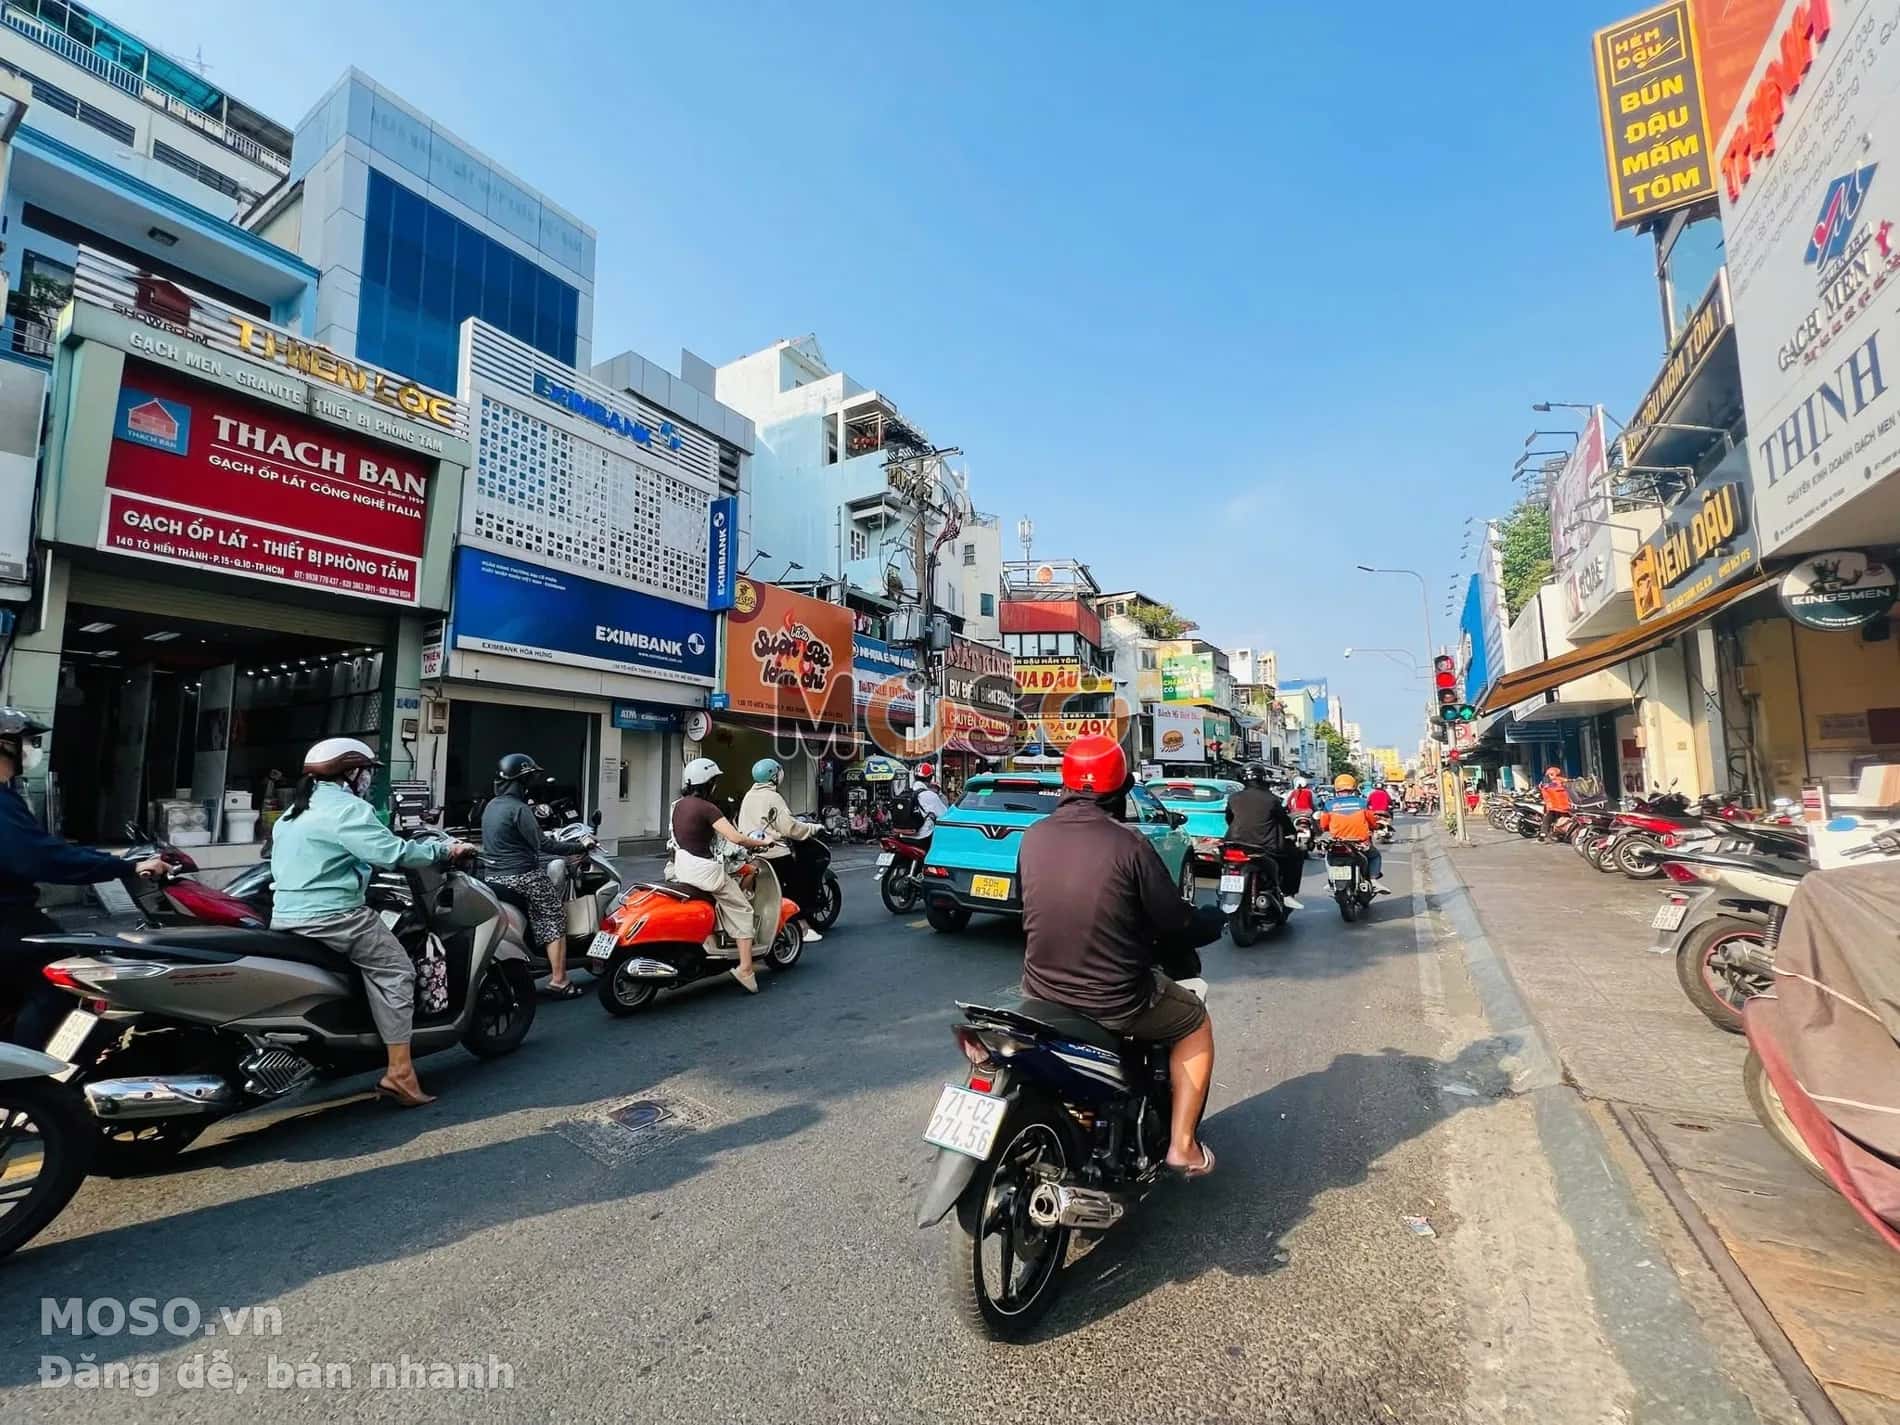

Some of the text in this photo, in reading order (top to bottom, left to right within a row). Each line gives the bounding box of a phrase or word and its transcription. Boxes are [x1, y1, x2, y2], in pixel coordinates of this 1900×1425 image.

[1620, 75, 1685, 114] BÚN
[1624, 106, 1690, 144] ĐẬU
[1622, 134, 1699, 177] MẮM
[1629, 167, 1701, 205] TÔM
[1825, 249, 1871, 320] MEN
[112, 303, 208, 346] SHOWROOM
[130, 331, 179, 362] GẠCH
[185, 351, 222, 378] MEN
[236, 370, 302, 405] GRANITE
[376, 416, 414, 443] PHÒNG
[375, 372, 458, 426] LỘC
[213, 415, 427, 497] THACH BAN
[208, 454, 422, 519] GẠCH ỐP LÁT CÔNG NGHỆ ITALIA
[115, 535, 133, 547] 140
[137, 538, 150, 550] TÔ
[123, 510, 409, 582] GẠCH ỐP LÁT THIẾT BỊ PHÒNG TẮM
[716, 528, 728, 597] EXIMBANK
[1791, 588, 1891, 606] KINGSMEN
[482, 641, 519, 654] EXIMBANK
[594, 625, 683, 657] EXIMBANK
[801, 668, 827, 690] chi
[949, 679, 961, 698] BV
[1041, 666, 1078, 692] ĐẬU
[620, 709, 638, 720] ATM
[1079, 719, 1116, 738] 49K
[945, 1090, 995, 1125] 71-C2
